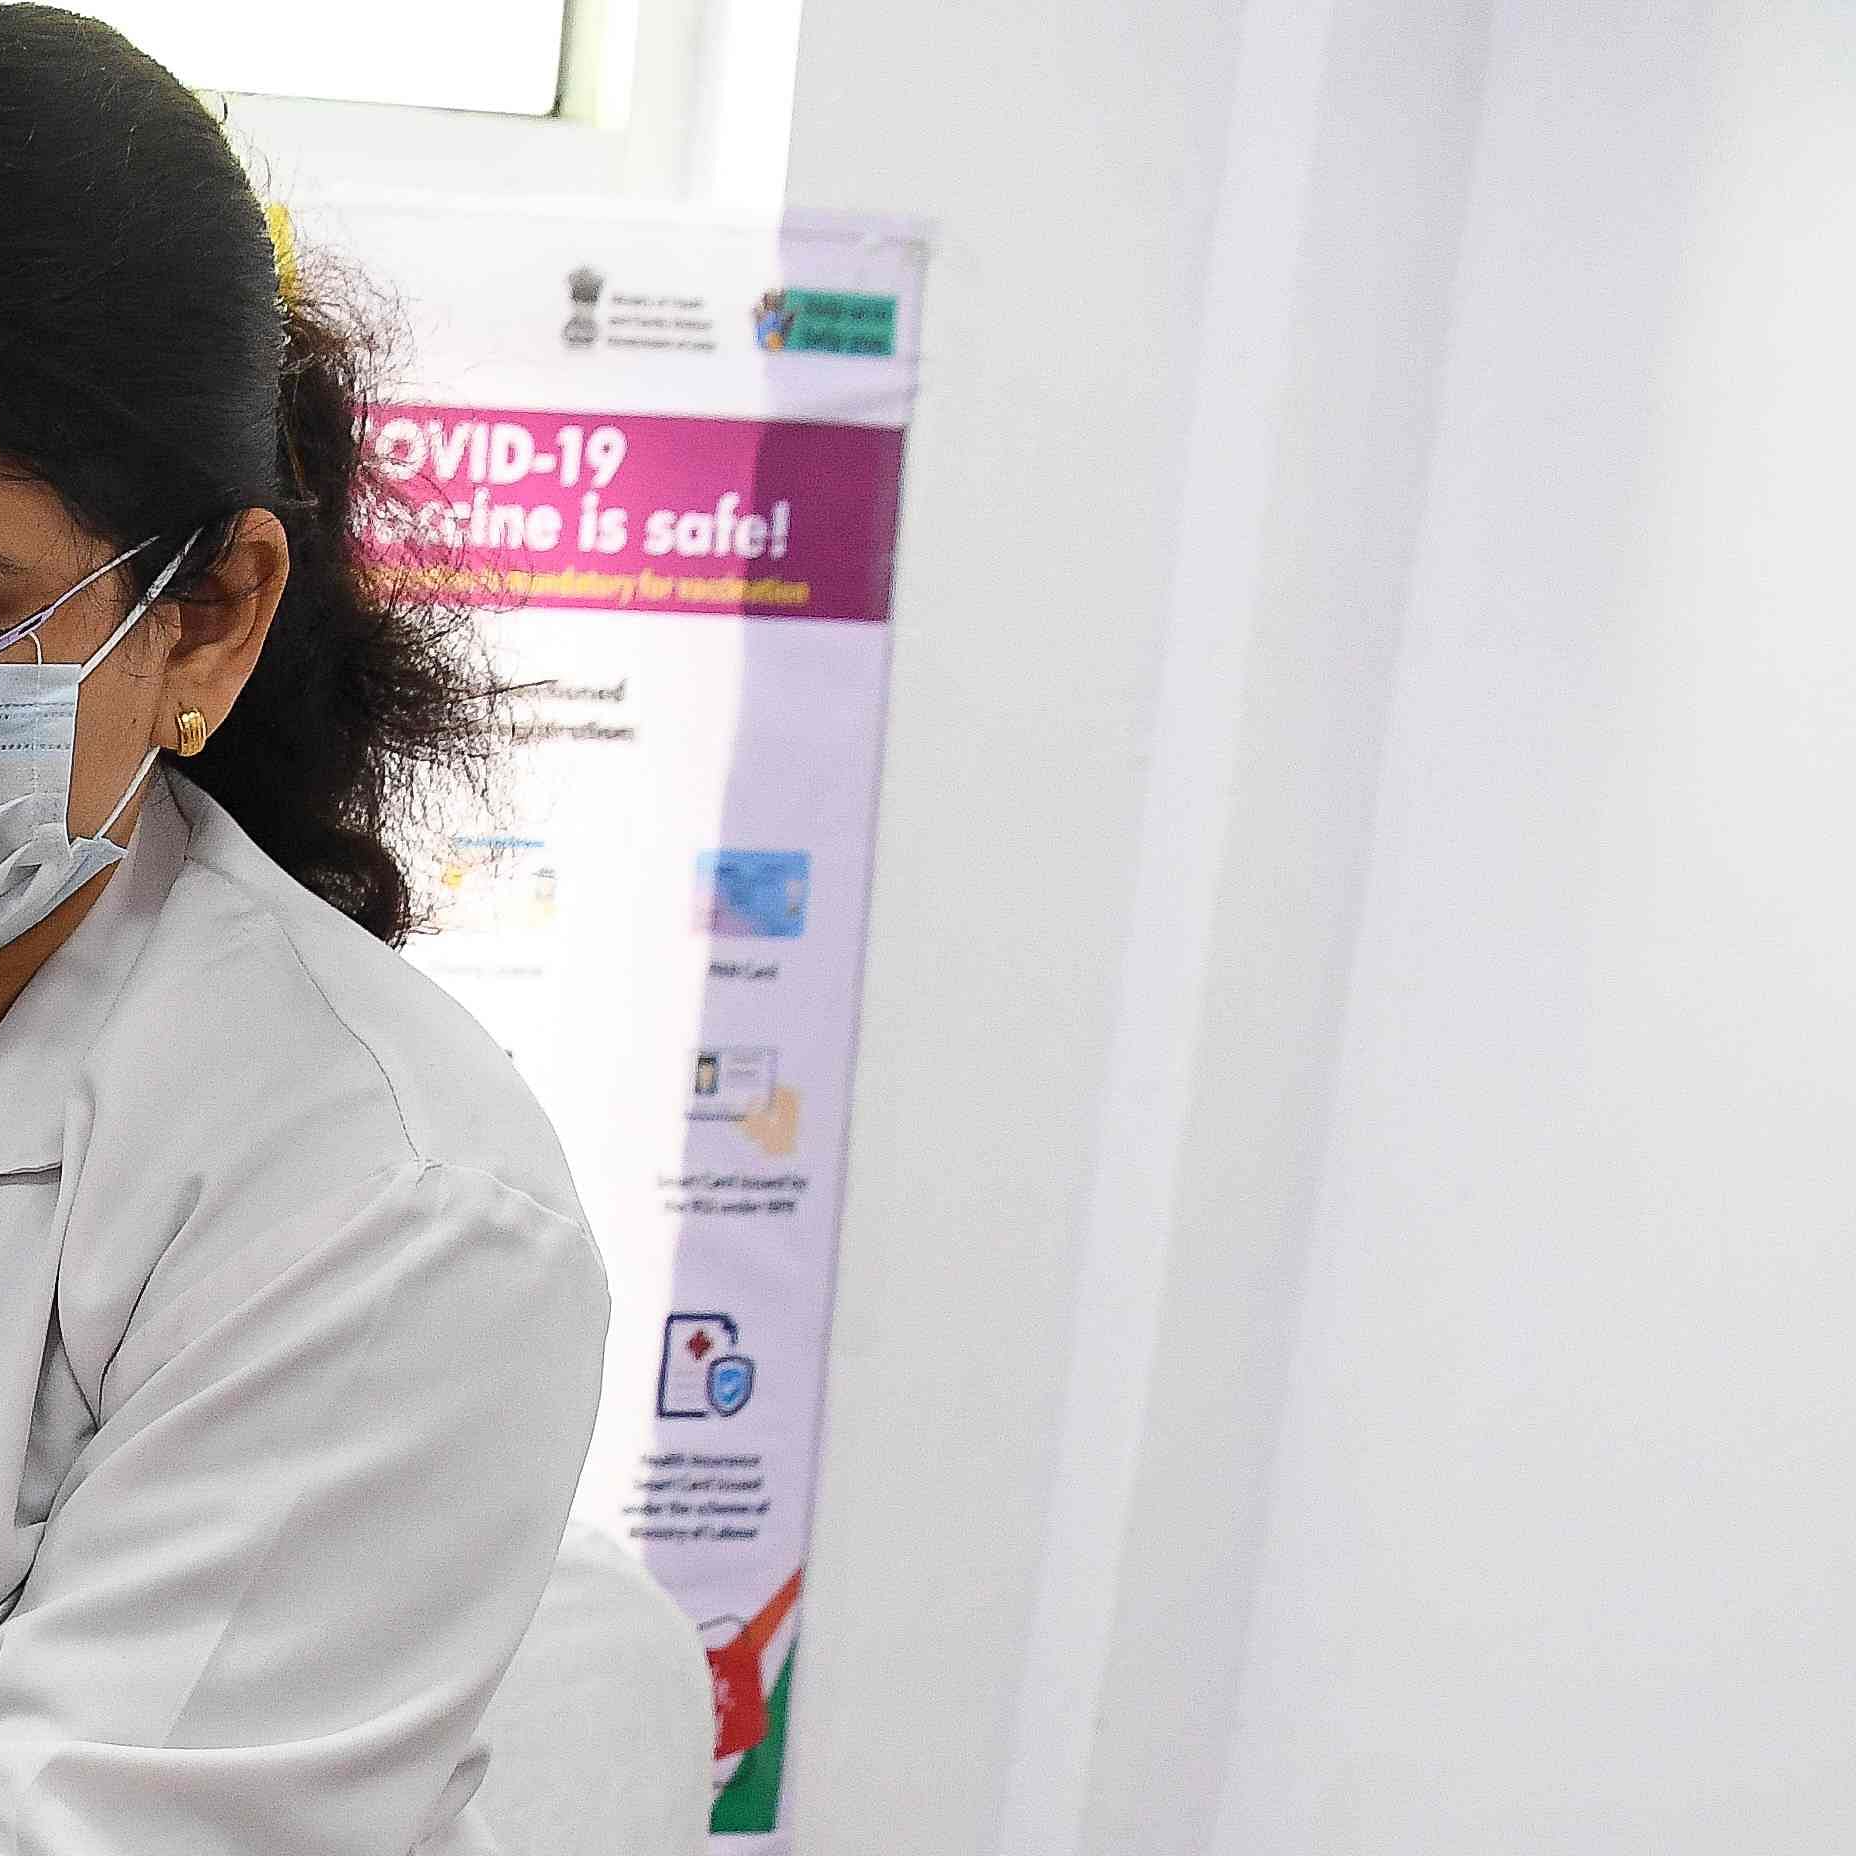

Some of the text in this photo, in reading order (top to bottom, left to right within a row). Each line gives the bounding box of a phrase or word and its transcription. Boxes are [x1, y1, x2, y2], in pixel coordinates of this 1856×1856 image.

[356, 418, 628, 489] OVID-19
[578, 491, 626, 553] is
[643, 491, 789, 561] safe!
